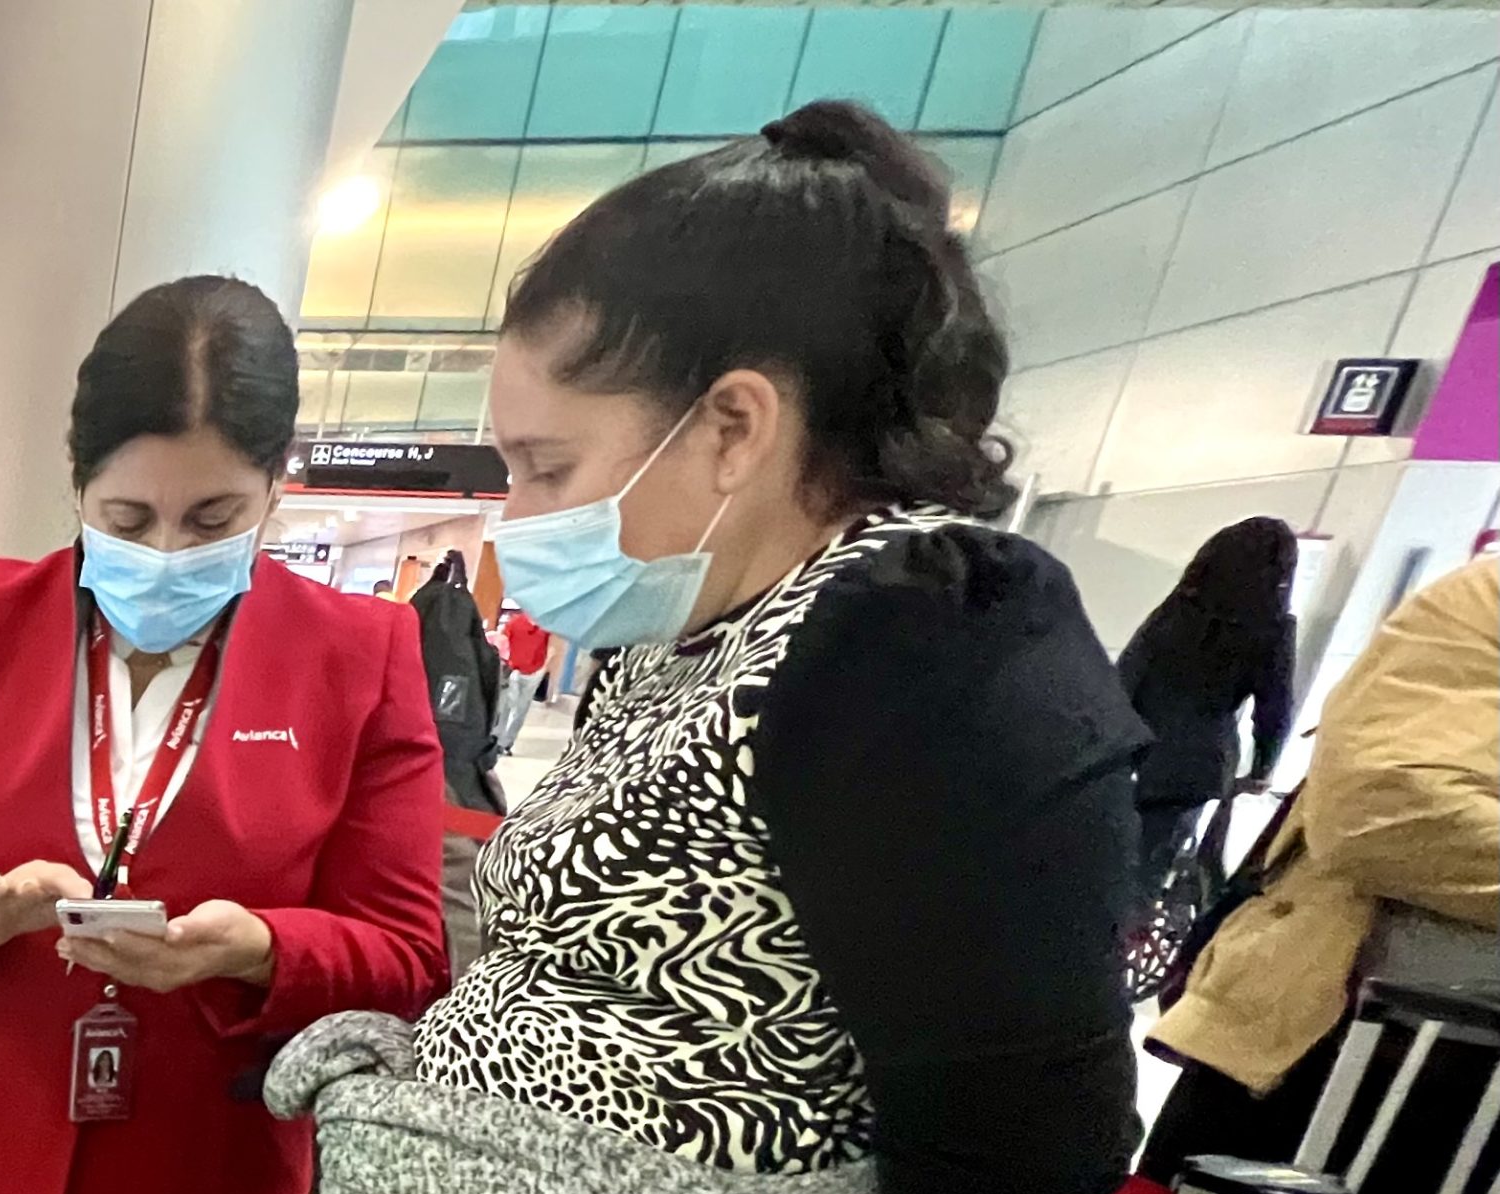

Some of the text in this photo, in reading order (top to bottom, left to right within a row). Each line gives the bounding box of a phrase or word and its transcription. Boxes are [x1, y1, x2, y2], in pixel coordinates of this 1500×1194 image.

[332, 444, 405, 459] Concourse
[423, 446, 435, 460] J
[166, 708, 194, 750] Avianca
[232, 729, 288, 742] Avianca
[98, 798, 113, 844] Avianca
